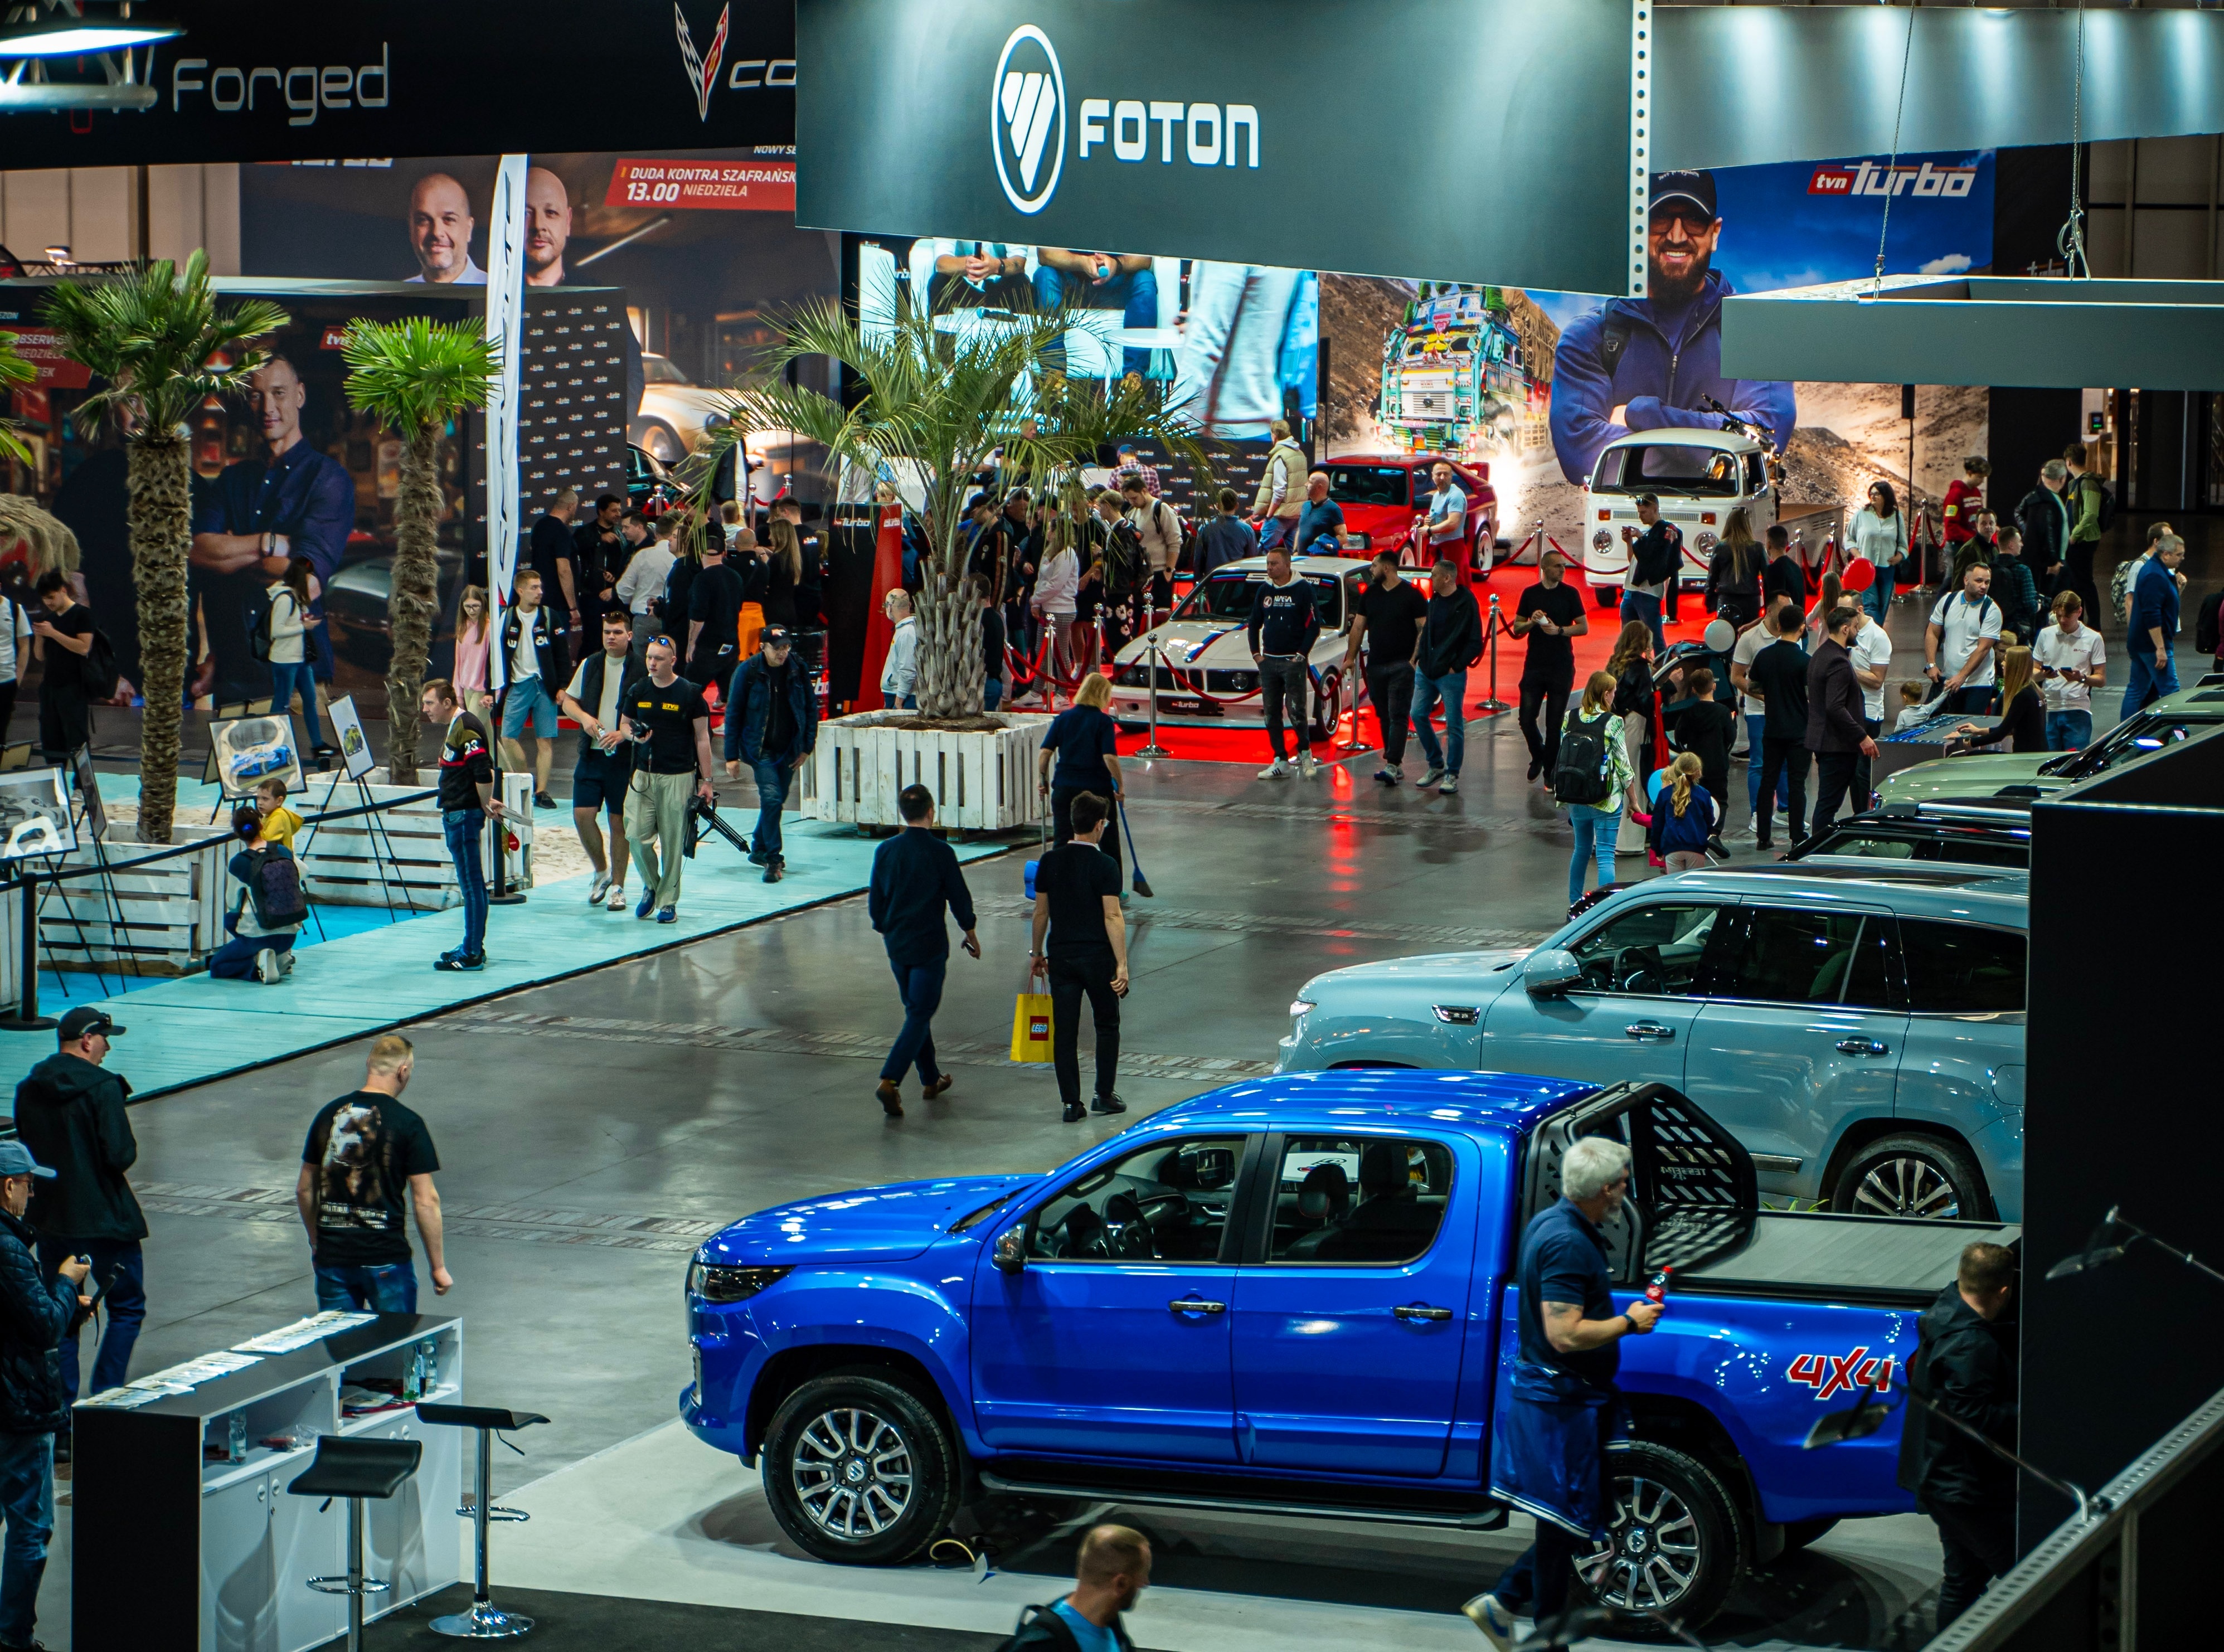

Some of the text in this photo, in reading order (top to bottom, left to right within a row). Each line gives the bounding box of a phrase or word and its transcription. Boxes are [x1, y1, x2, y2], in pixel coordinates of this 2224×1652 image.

[173, 42, 388, 127] Forged
[1080, 99, 1259, 168] FOTON
[754, 145, 785, 154] NOWY
[630, 168, 667, 179] DUDA
[667, 168, 718, 181] KONTRA
[1817, 174, 1847, 189] tvn
[627, 182, 748, 201] 13.00 NIEDZIELA
[464, 739, 479, 755] 23
[1031, 1023, 1047, 1033] LEGO
[1785, 1346, 1894, 1400] 4X4
